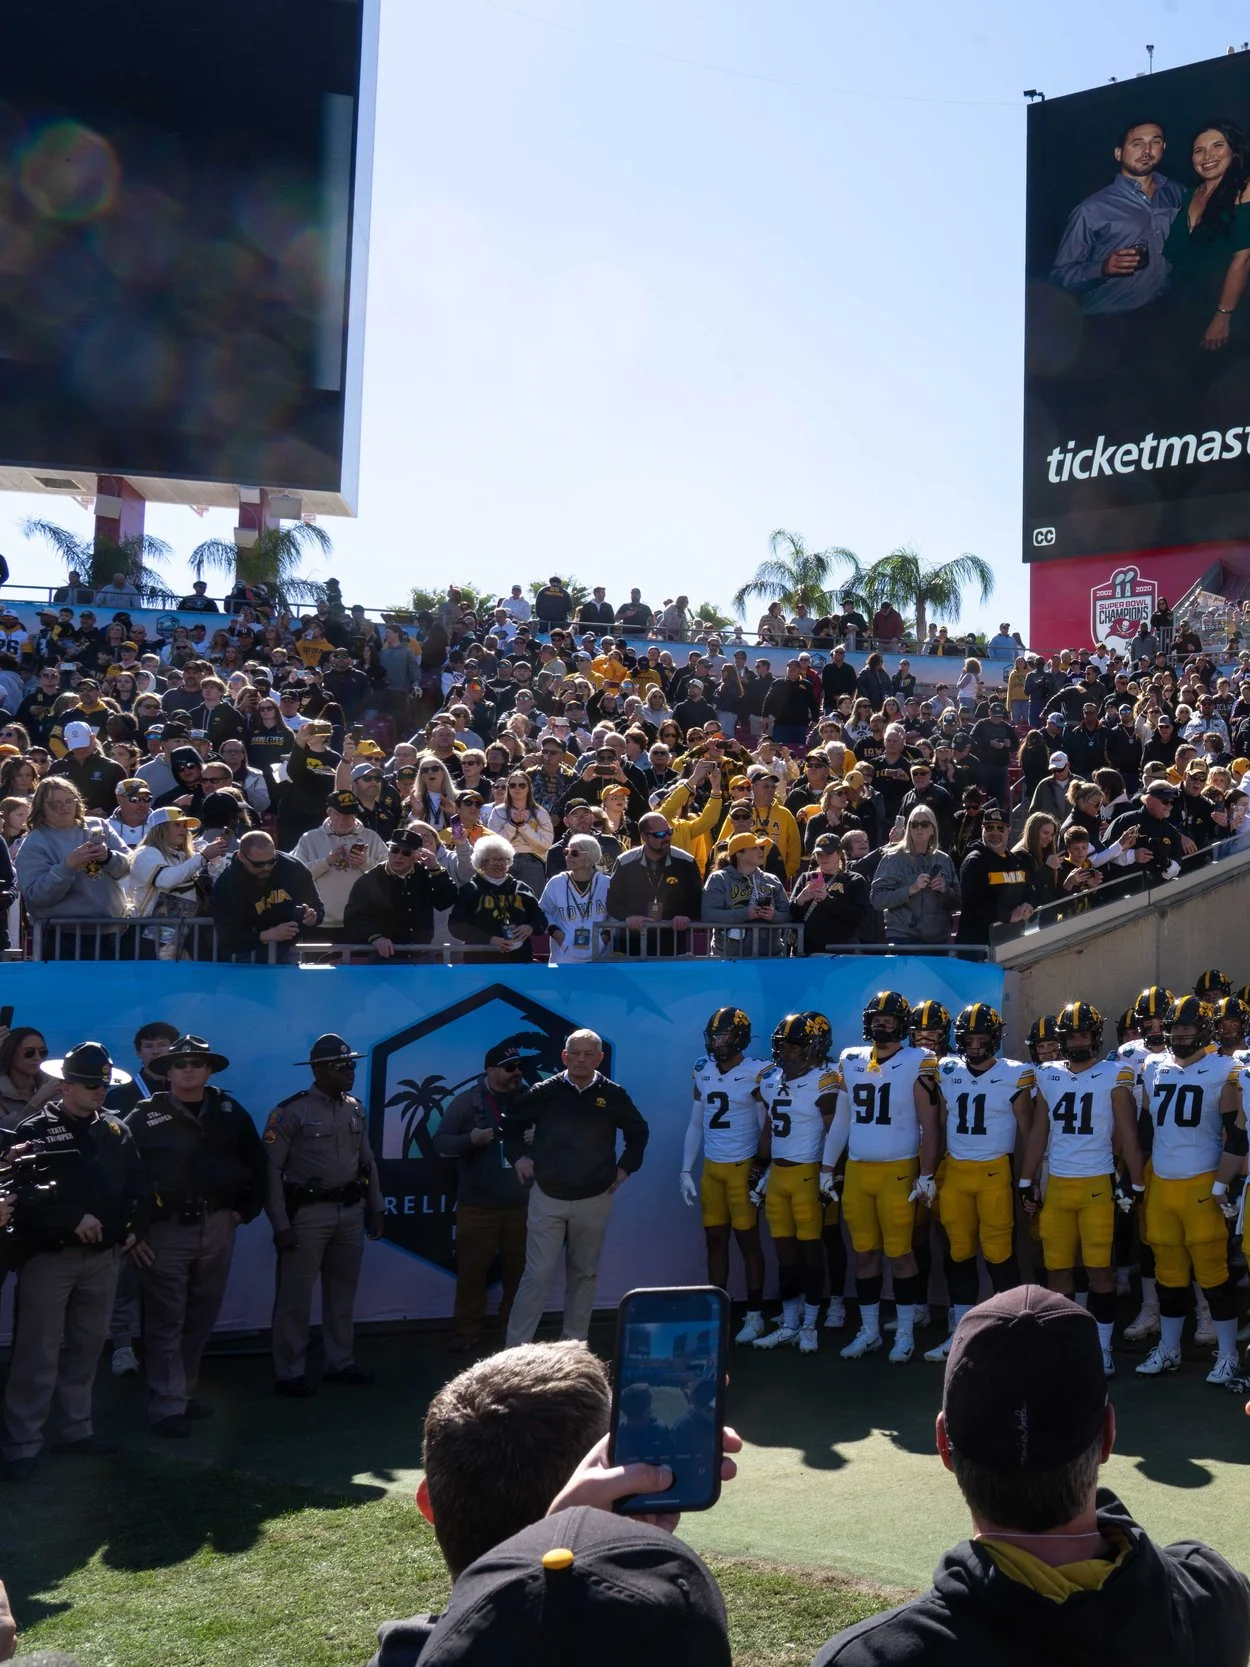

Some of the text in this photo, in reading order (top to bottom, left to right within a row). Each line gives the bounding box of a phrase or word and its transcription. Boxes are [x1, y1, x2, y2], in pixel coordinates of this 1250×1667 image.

[1034, 530, 1054, 545] CC
[1096, 589, 1113, 597] 2002
[1135, 585, 1152, 593] 2020
[1099, 599, 1149, 611] SUPER BOWL
[1098, 606, 1149, 625] CHAMPIONS
[251, 736, 284, 745] HAWKEYES
[556, 900, 608, 922] IOWA
[706, 1091, 731, 1130] 2
[852, 1082, 892, 1125] 91
[1052, 1091, 1094, 1135] 41
[1153, 1083, 1204, 1128] 70
[145, 1113, 173, 1127] TROOPER
[771, 1098, 792, 1138] 5
[955, 1092, 987, 1135] 11
[45, 1132, 74, 1143] TROOPER
[46, 1125, 67, 1135] STATE
[384, 1195, 458, 1216] RELI
